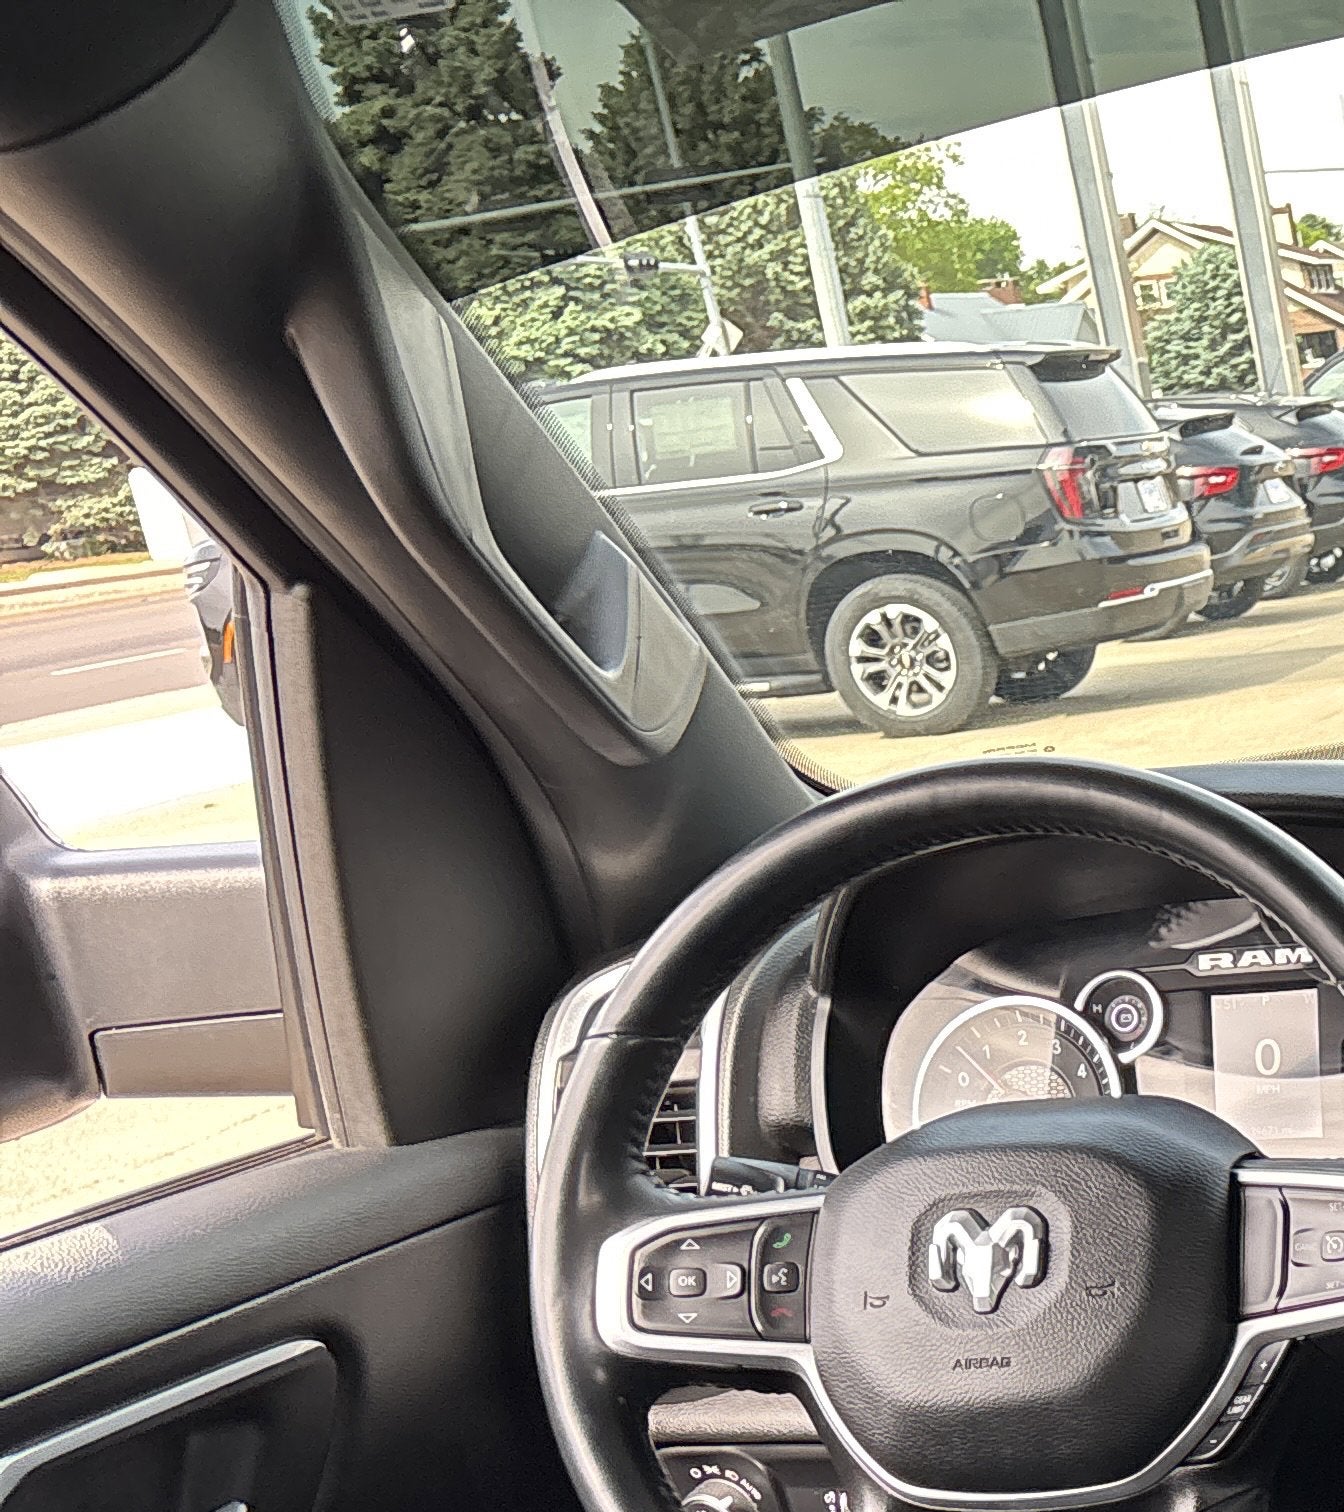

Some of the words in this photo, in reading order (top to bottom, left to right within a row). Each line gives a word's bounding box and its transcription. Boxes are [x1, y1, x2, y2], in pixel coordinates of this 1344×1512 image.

[1198, 947, 1313, 971] RAM
[1017, 1030, 1029, 1046] 2
[983, 1044, 991, 1059] 1
[1051, 1038, 1062, 1055] 3
[1255, 1038, 1281, 1076] 0
[1077, 1062, 1088, 1079] 4
[957, 1071, 970, 1087] 0
[678, 1275, 697, 1287] OK
[952, 1356, 1012, 1371] AIRBAG
